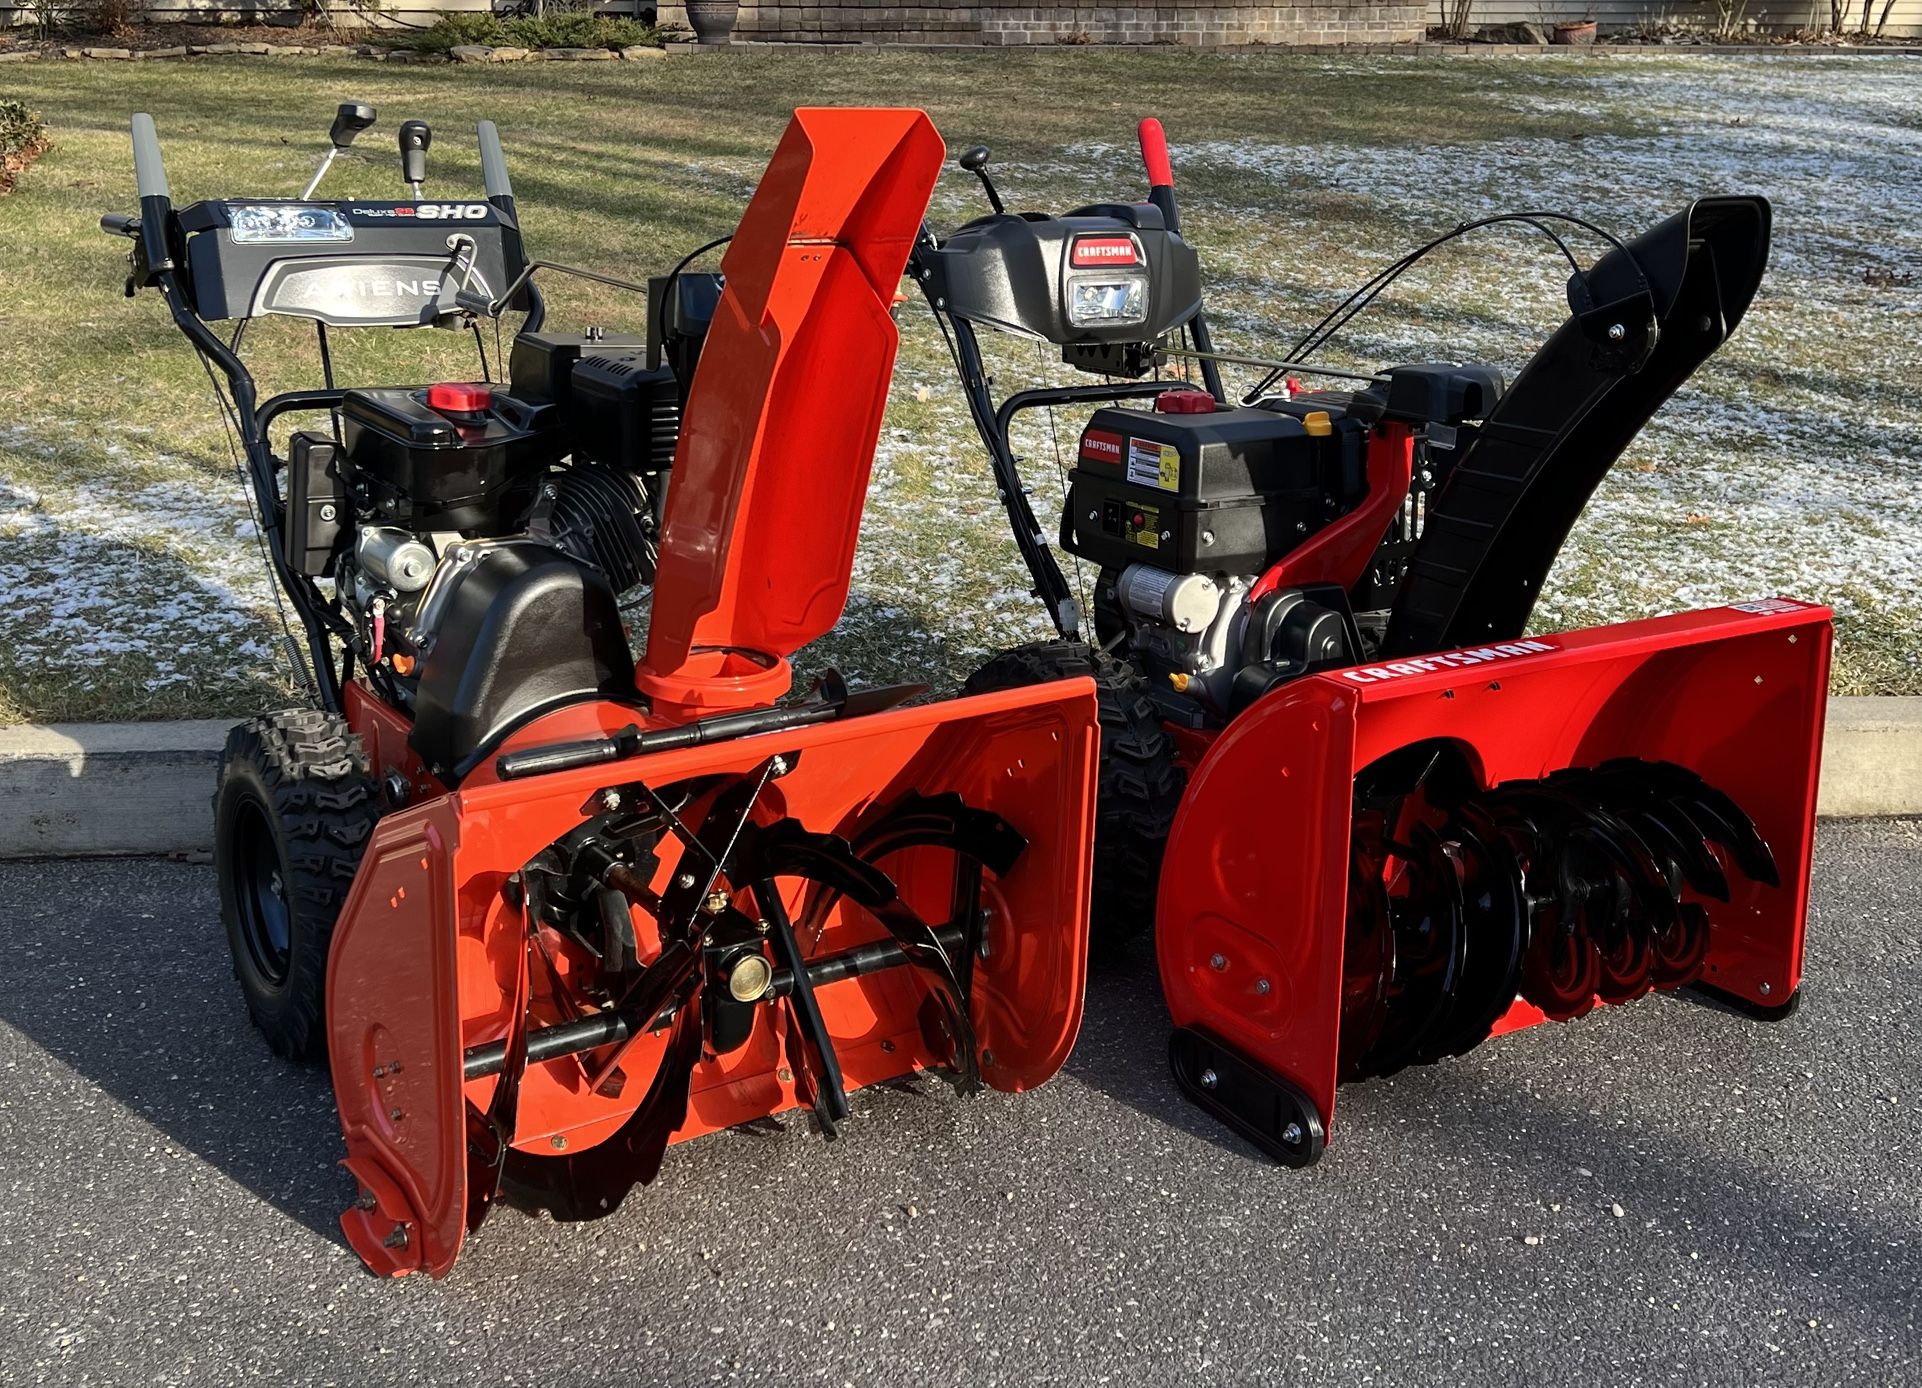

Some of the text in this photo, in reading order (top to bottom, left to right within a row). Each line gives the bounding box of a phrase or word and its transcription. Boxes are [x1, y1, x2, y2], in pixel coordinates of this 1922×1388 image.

[415, 204, 488, 219] SHO
[1077, 245, 1132, 257] CRAFTSMAN
[303, 280, 442, 298] AIENS
[1084, 438, 1120, 454] CRAFTSMAN
[1342, 640, 1556, 683] CRAFTSMAN
